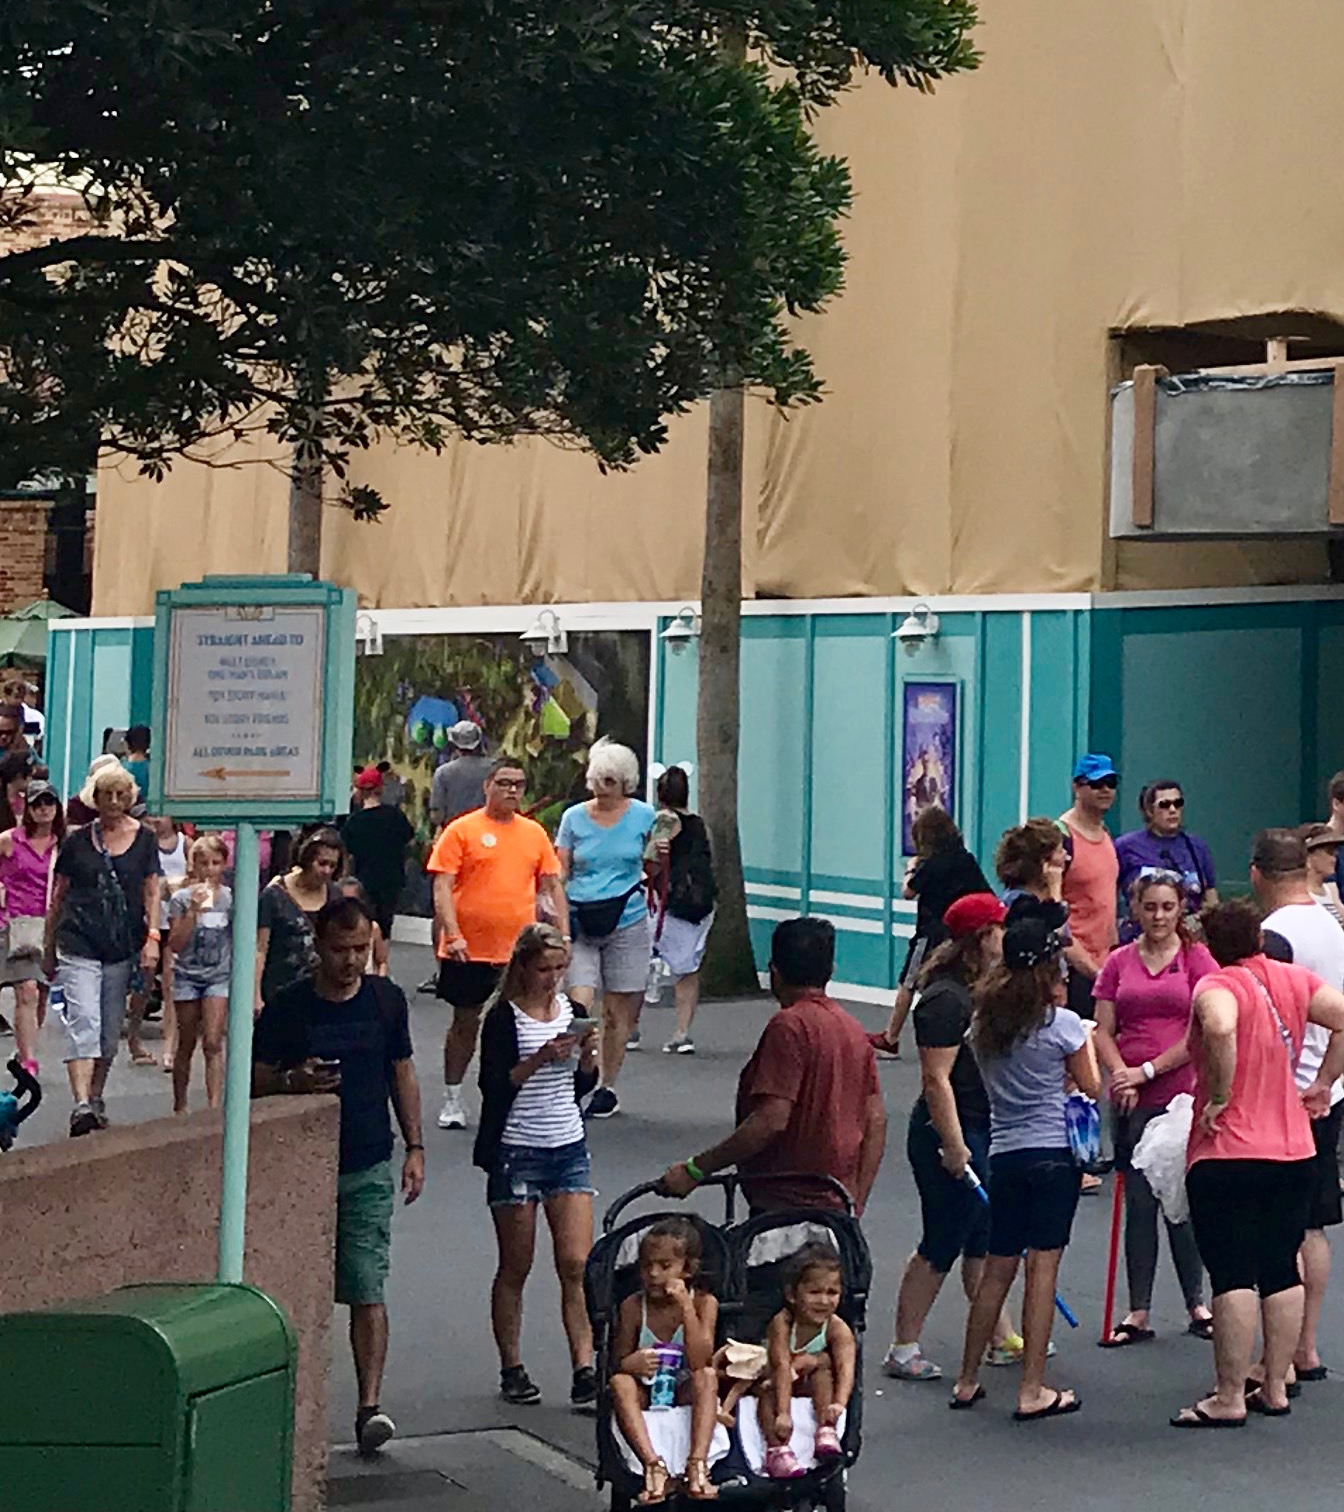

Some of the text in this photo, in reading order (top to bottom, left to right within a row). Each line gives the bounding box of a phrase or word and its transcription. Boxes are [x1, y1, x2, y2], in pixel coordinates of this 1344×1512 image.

[197, 633, 304, 646] STRAIGHT AHEAD TO
